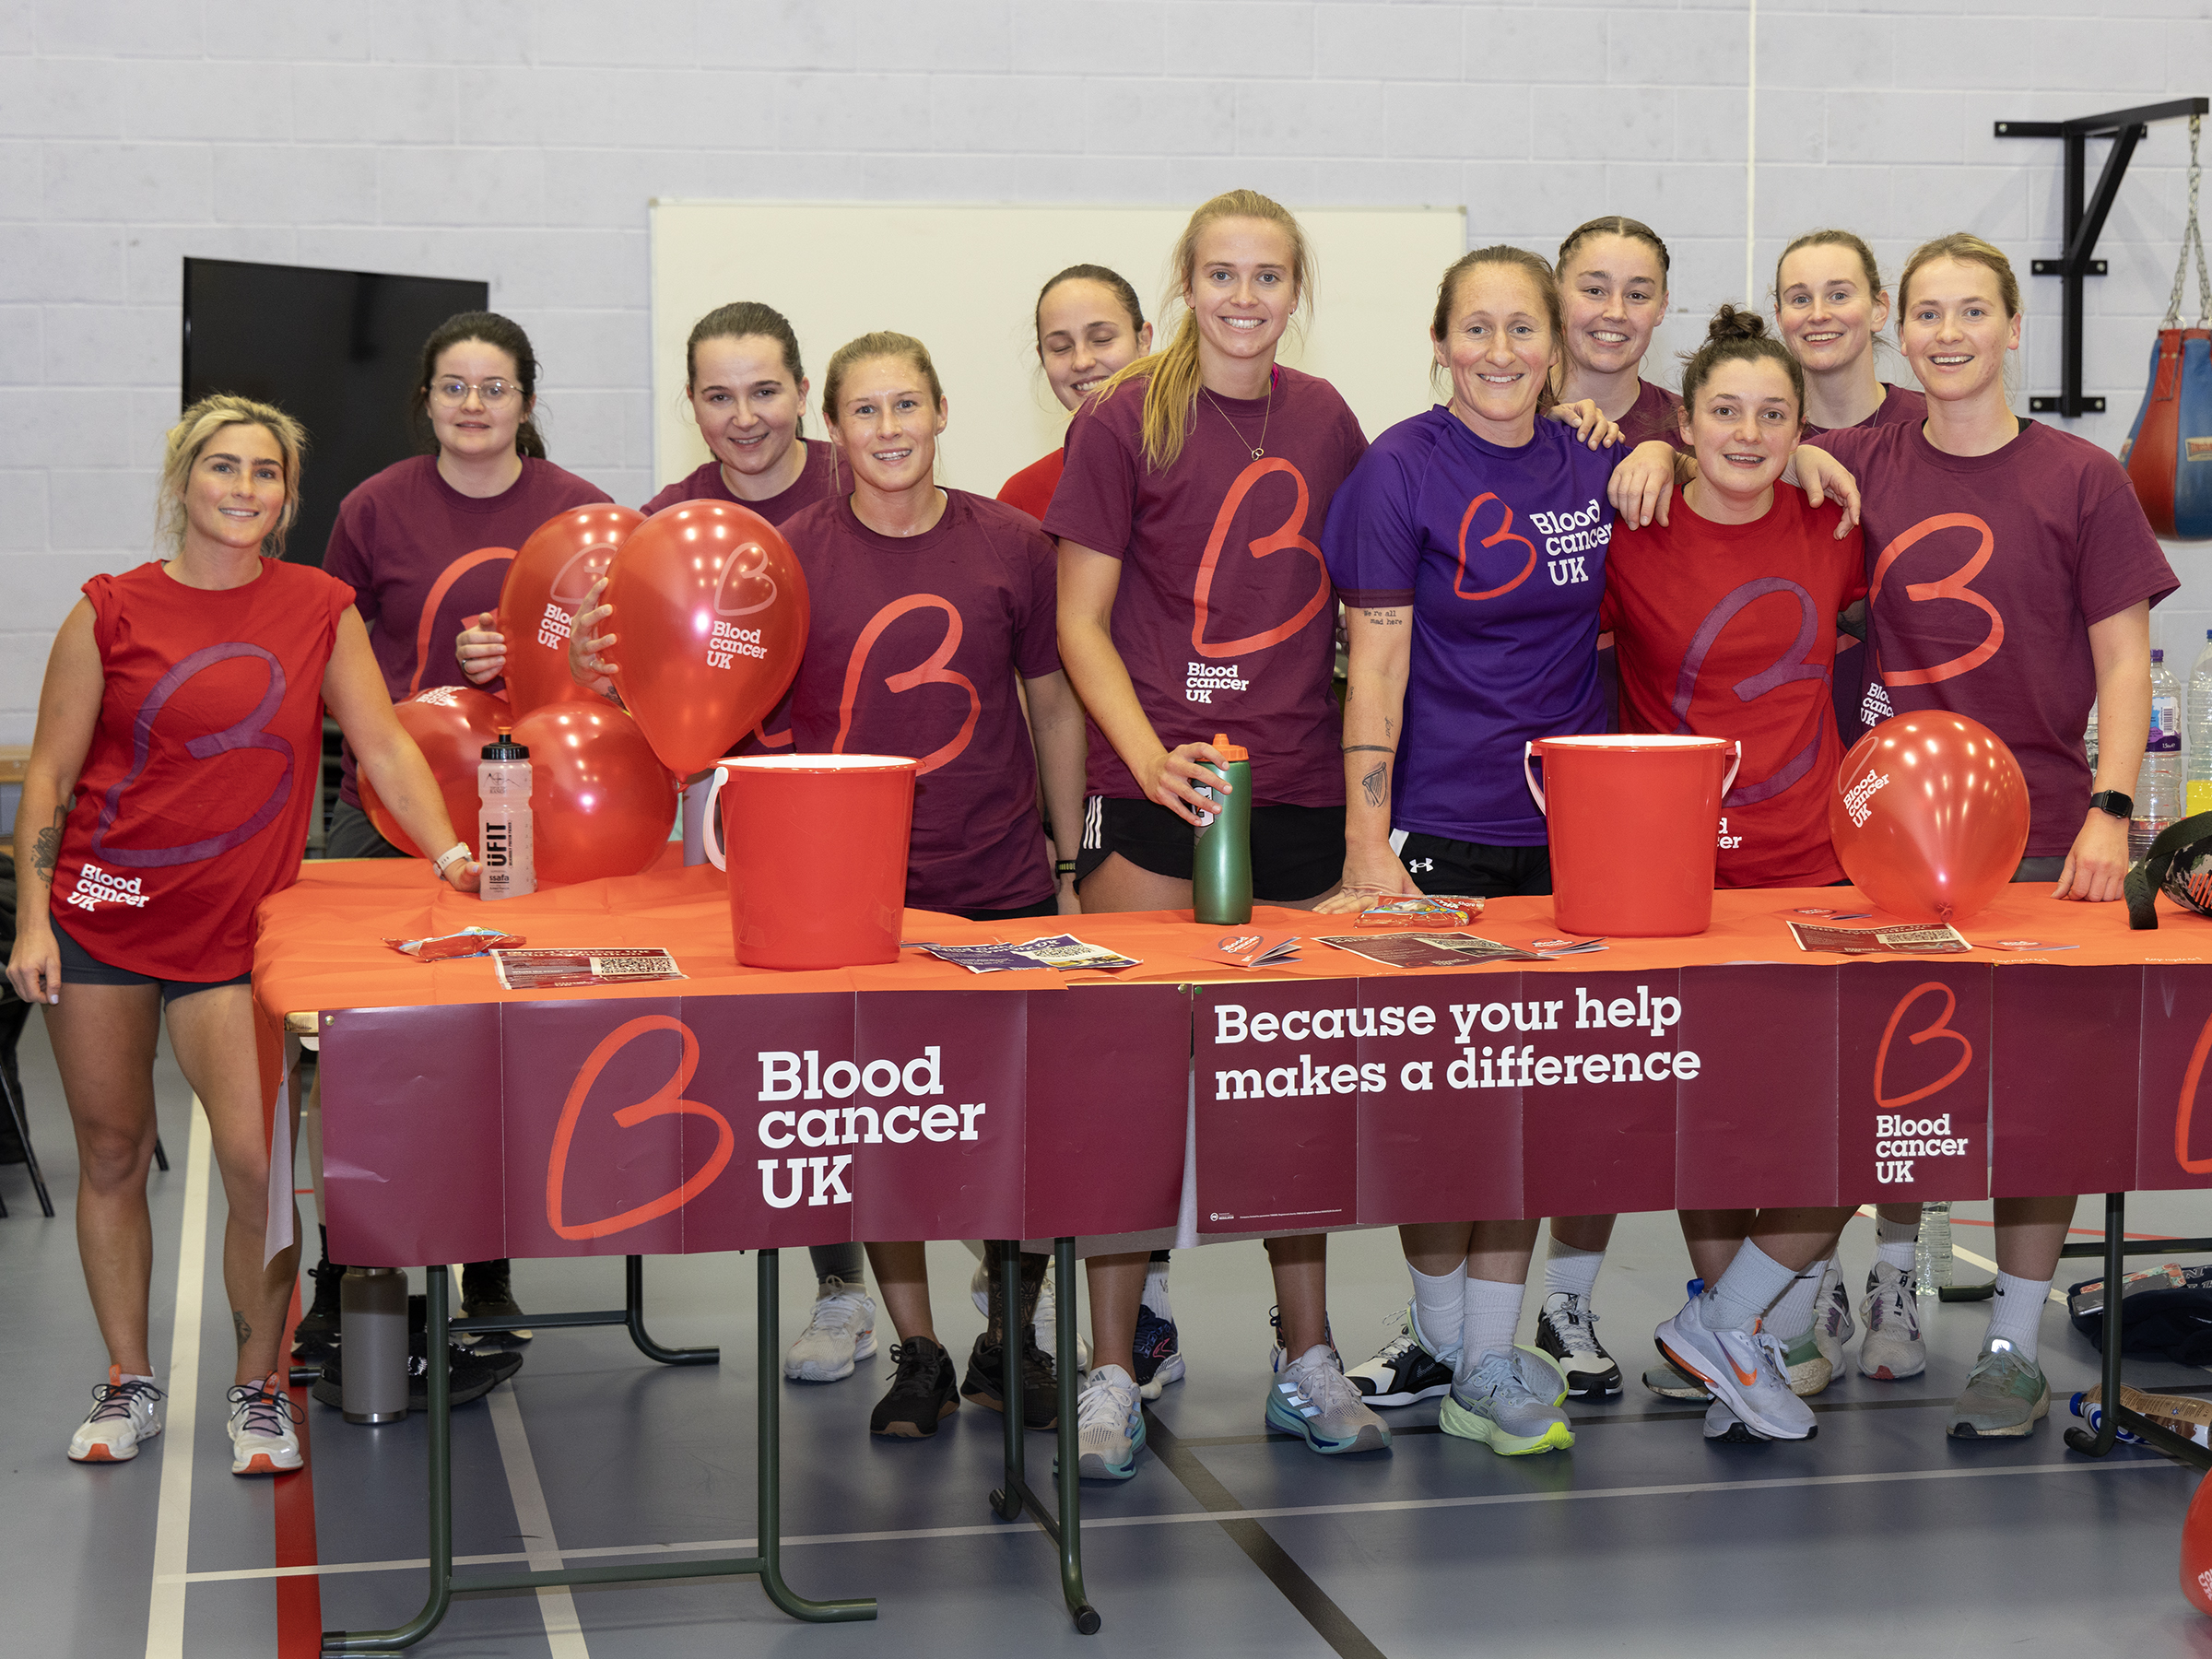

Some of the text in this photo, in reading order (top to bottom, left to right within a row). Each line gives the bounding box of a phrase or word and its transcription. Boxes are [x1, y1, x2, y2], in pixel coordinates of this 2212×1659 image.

[1529, 499, 1601, 535] Blood
[1546, 523, 1613, 557] cancer
[1547, 556, 1589, 586] UK
[543, 603, 572, 627] Blo
[537, 629, 561, 651] UK
[540, 618, 571, 639] can
[712, 620, 762, 644] Blood
[706, 650, 735, 670] UK
[709, 637, 768, 660] cancer
[1186, 662, 1239, 678] Blood
[1185, 677, 1250, 691] cancer
[1185, 688, 1213, 704] UK
[1866, 682, 1890, 704] Blo
[1860, 707, 1879, 727] UK
[1862, 697, 1894, 718] canc
[1842, 769, 1878, 809] Blood
[1848, 773, 1889, 817] cancer
[1852, 803, 1872, 828] UK
[79, 863, 142, 895] Blood
[66, 890, 102, 912] UK
[76, 878, 150, 908] cancer
[1215, 985, 1682, 1044] Because your help
[758, 1045, 944, 1101] Blood
[1216, 1045, 1701, 1100] makes a difference
[758, 1102, 986, 1149] cancer
[1876, 1113, 1951, 1137] Blood
[1876, 1137, 1969, 1159] cancer
[758, 1154, 853, 1209] UK
[1876, 1159, 1914, 1184] UK
